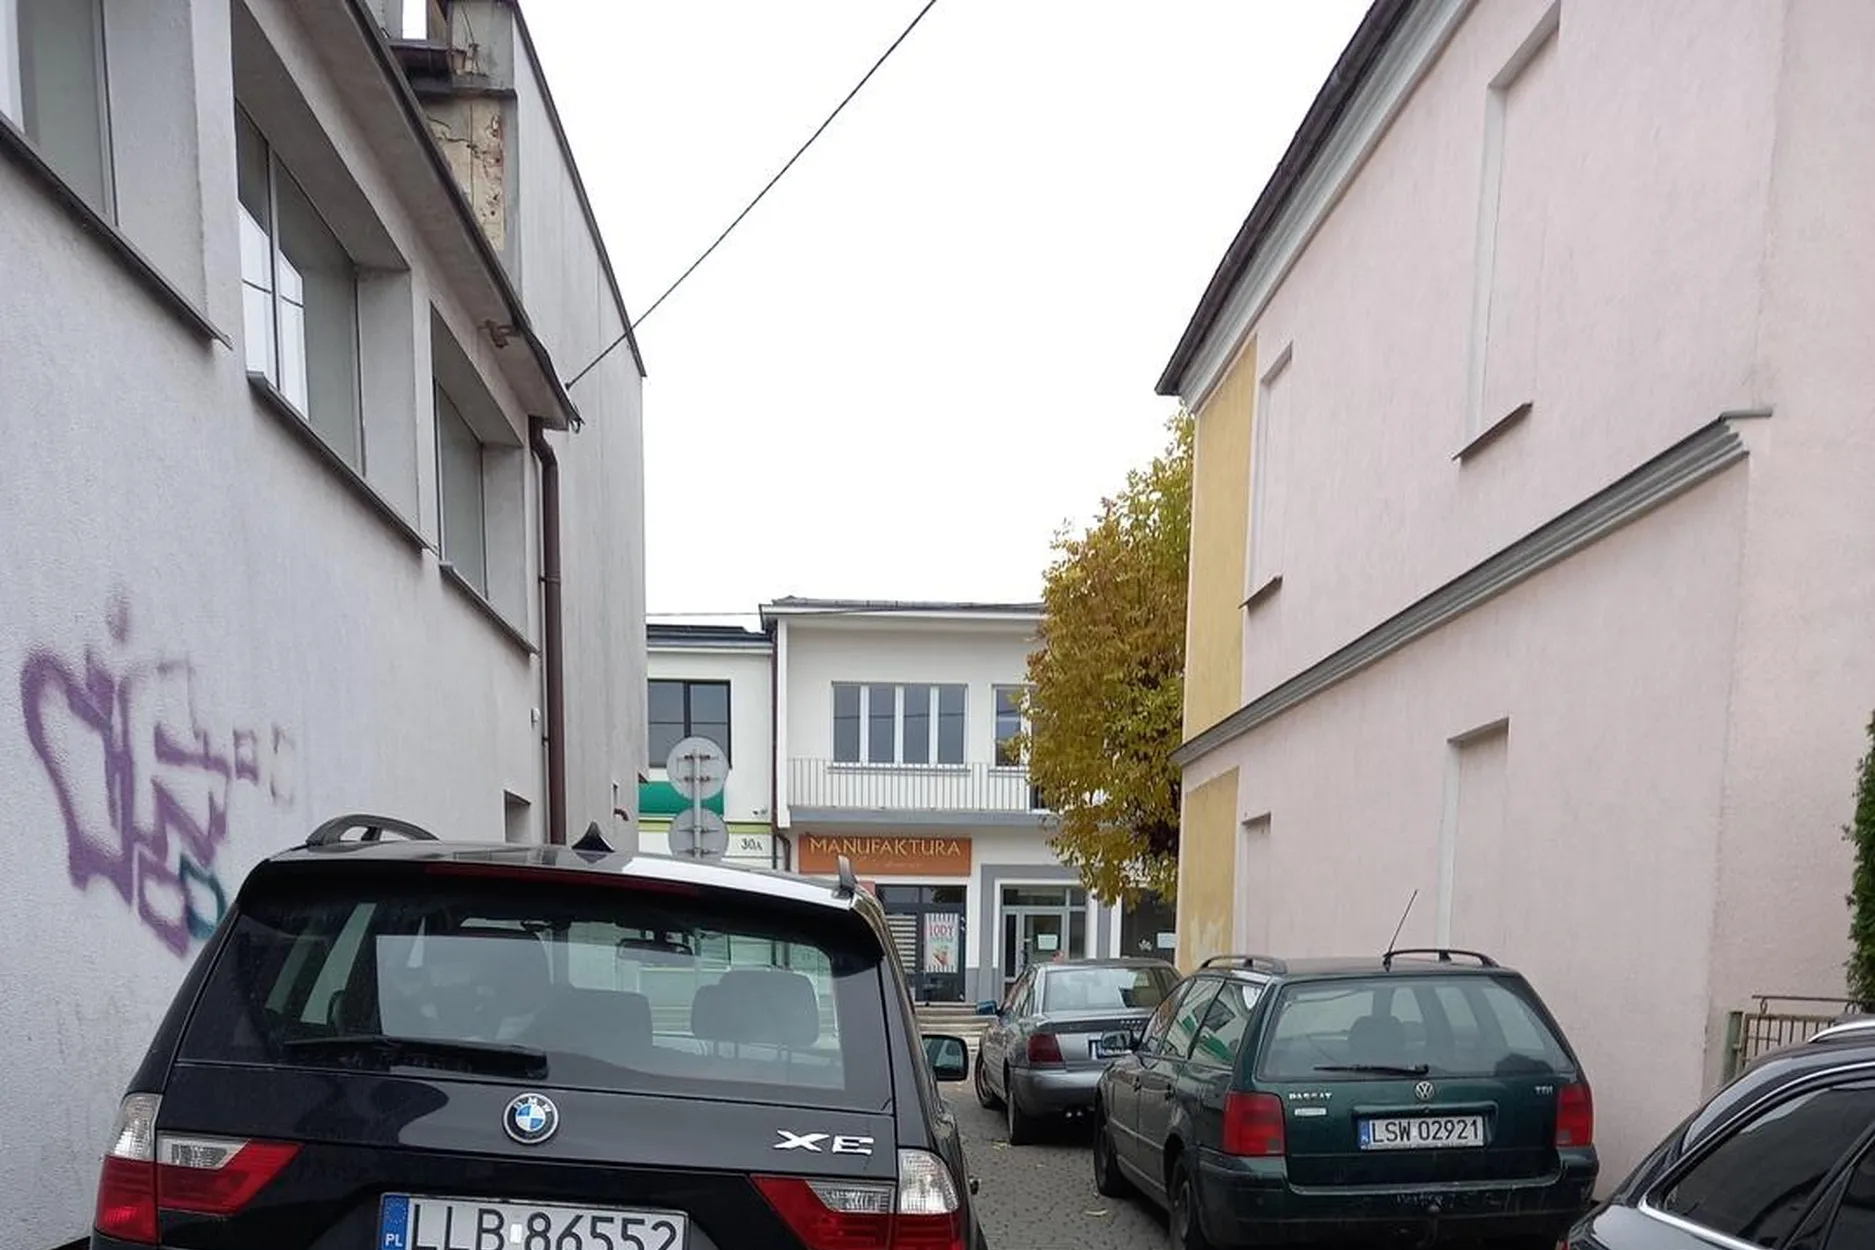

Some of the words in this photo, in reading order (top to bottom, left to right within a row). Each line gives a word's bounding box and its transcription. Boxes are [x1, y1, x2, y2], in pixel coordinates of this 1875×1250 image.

[809, 837, 961, 856] MANUFAKTURA
[513, 1096, 551, 1112] BMW
[1372, 1120, 1411, 1143] LSW
[1418, 1118, 1479, 1142] 02921
[385, 1233, 402, 1247] PL
